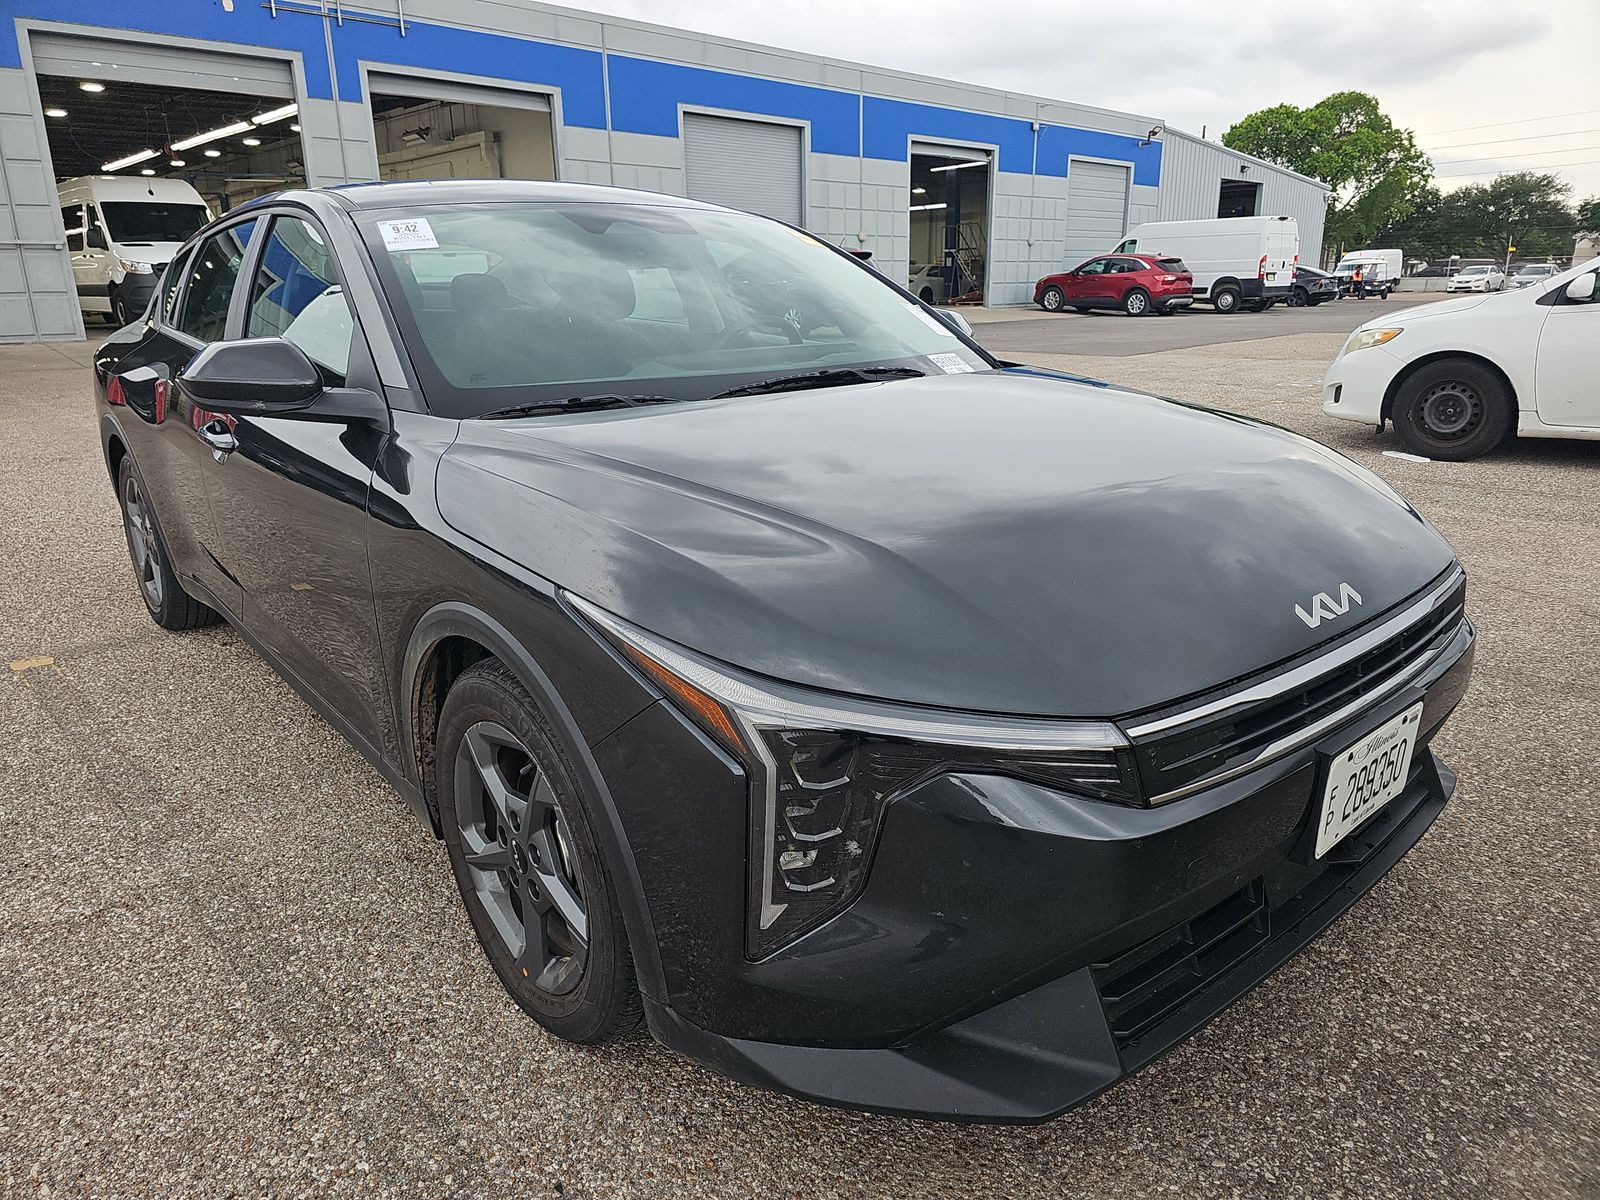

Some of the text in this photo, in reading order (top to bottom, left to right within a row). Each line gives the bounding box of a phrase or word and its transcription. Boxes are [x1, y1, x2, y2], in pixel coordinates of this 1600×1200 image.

[392, 224, 418, 234] 9:42
[1353, 726, 1400, 765] Illinois
[1341, 737, 1408, 823] 289350
